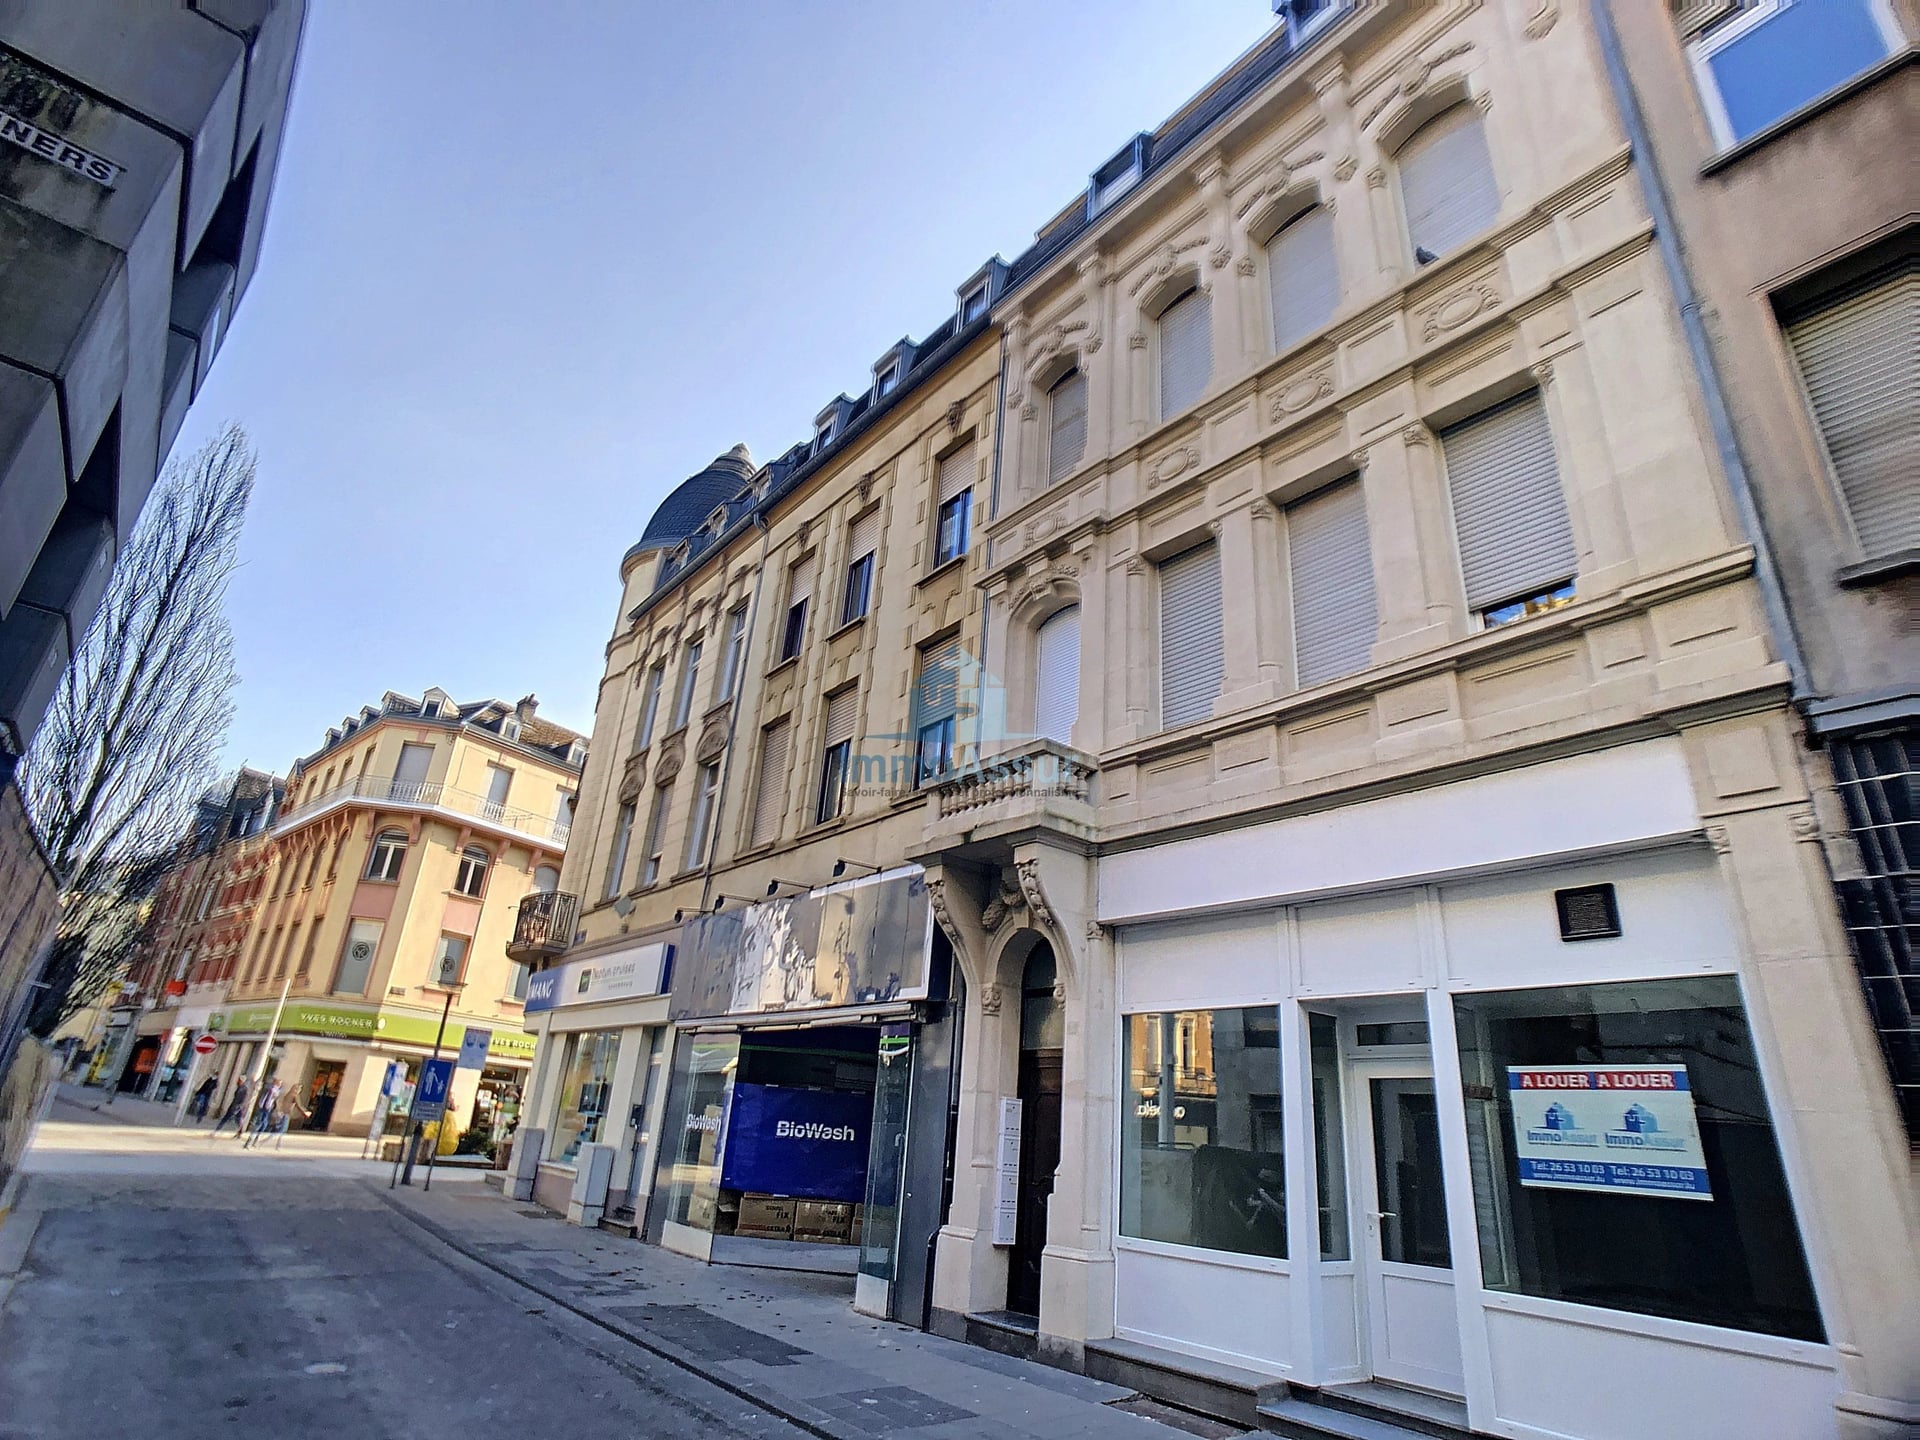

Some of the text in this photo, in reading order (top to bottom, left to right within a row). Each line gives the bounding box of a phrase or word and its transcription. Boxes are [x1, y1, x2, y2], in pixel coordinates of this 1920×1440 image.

[1, 118, 112, 181] NERS
[300, 1012, 374, 1029] YVES ROCHER
[1522, 1074, 1591, 1088] A LOUER
[1597, 1073, 1674, 1088] A LOUER
[686, 1113, 722, 1131] BioWash
[775, 1120, 856, 1141] BioWash
[1550, 1162, 1563, 1172] 26
[1563, 1162, 1576, 1173] 53
[1631, 1167, 1646, 1177] 26
[1647, 1168, 1661, 1178] 53
